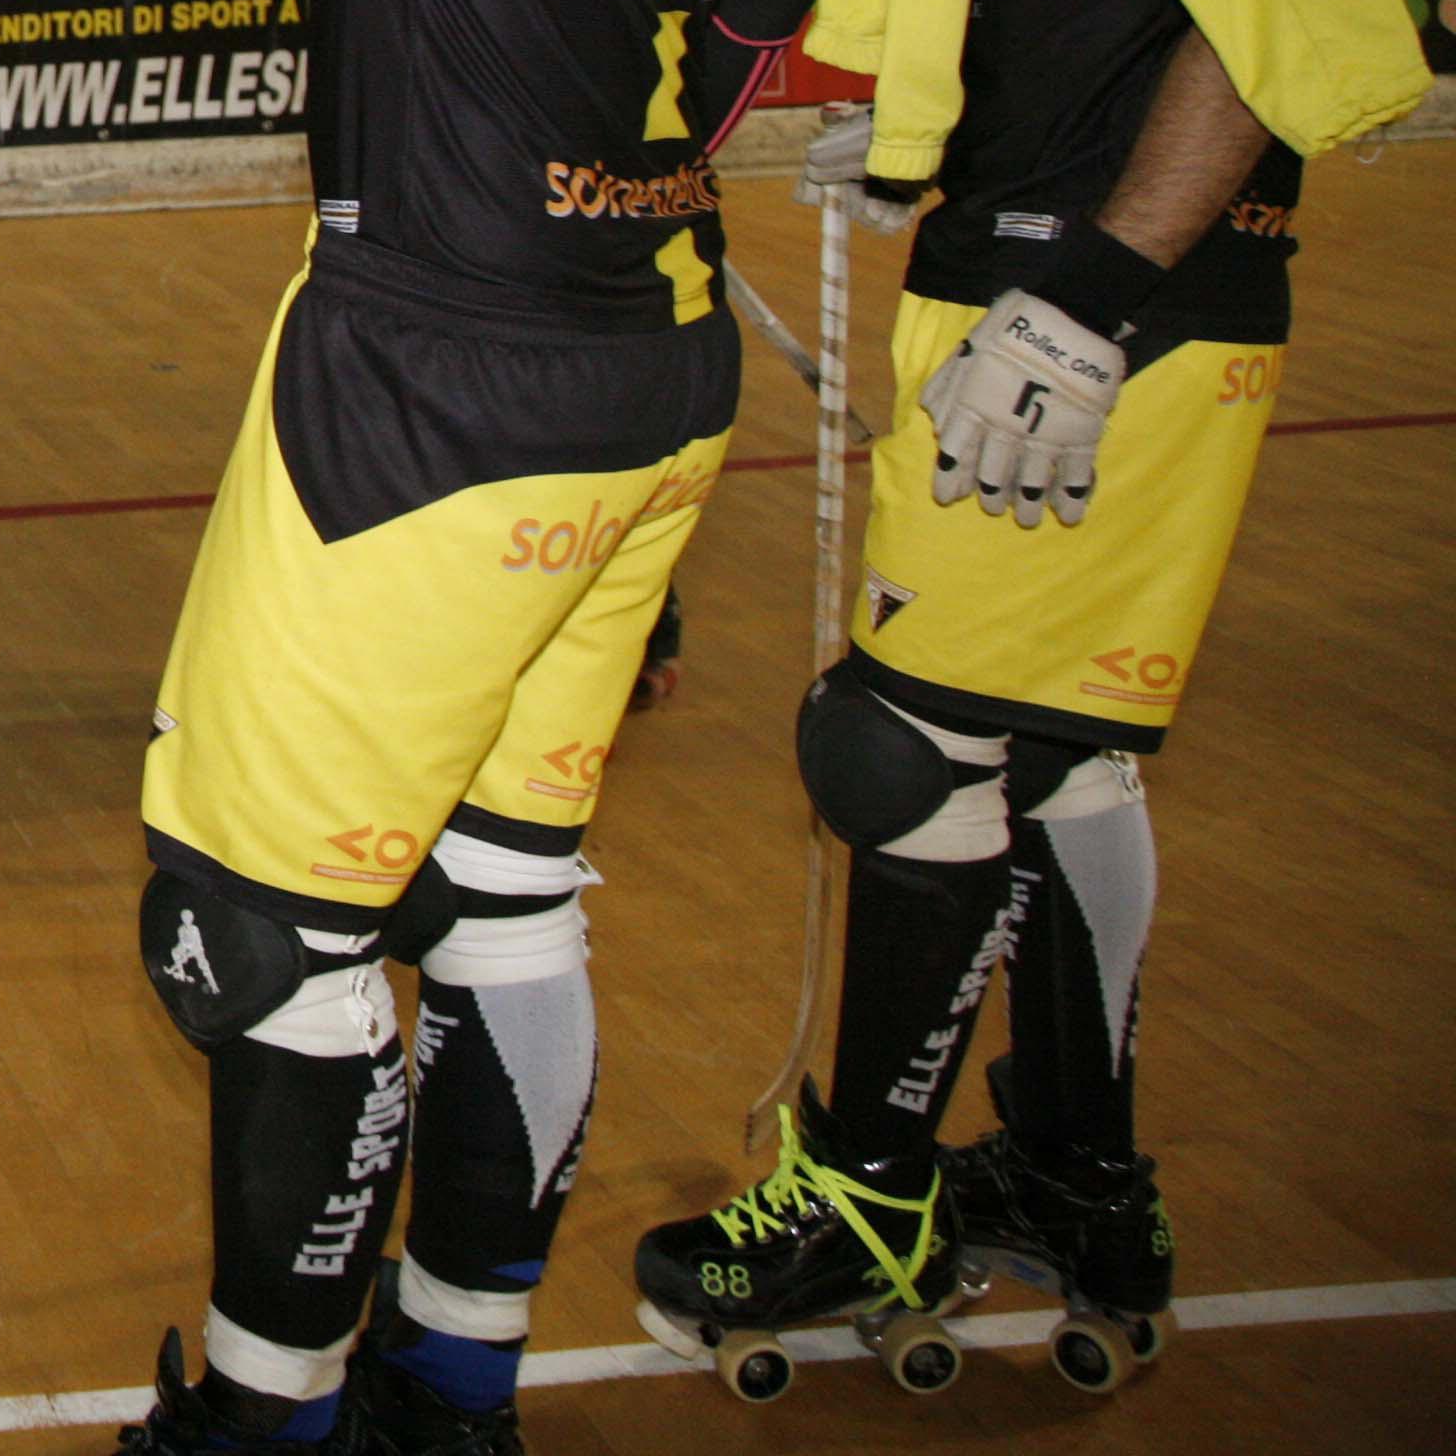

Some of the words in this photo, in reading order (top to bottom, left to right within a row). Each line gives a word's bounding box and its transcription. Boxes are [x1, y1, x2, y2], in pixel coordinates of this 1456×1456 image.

[132, 3, 166, 37] DI
[885, 1022, 962, 1116] ELLE
[291, 1184, 375, 1278] ELLE
[346, 1051, 408, 1182] SPORT
[698, 1258, 755, 1300] 88
